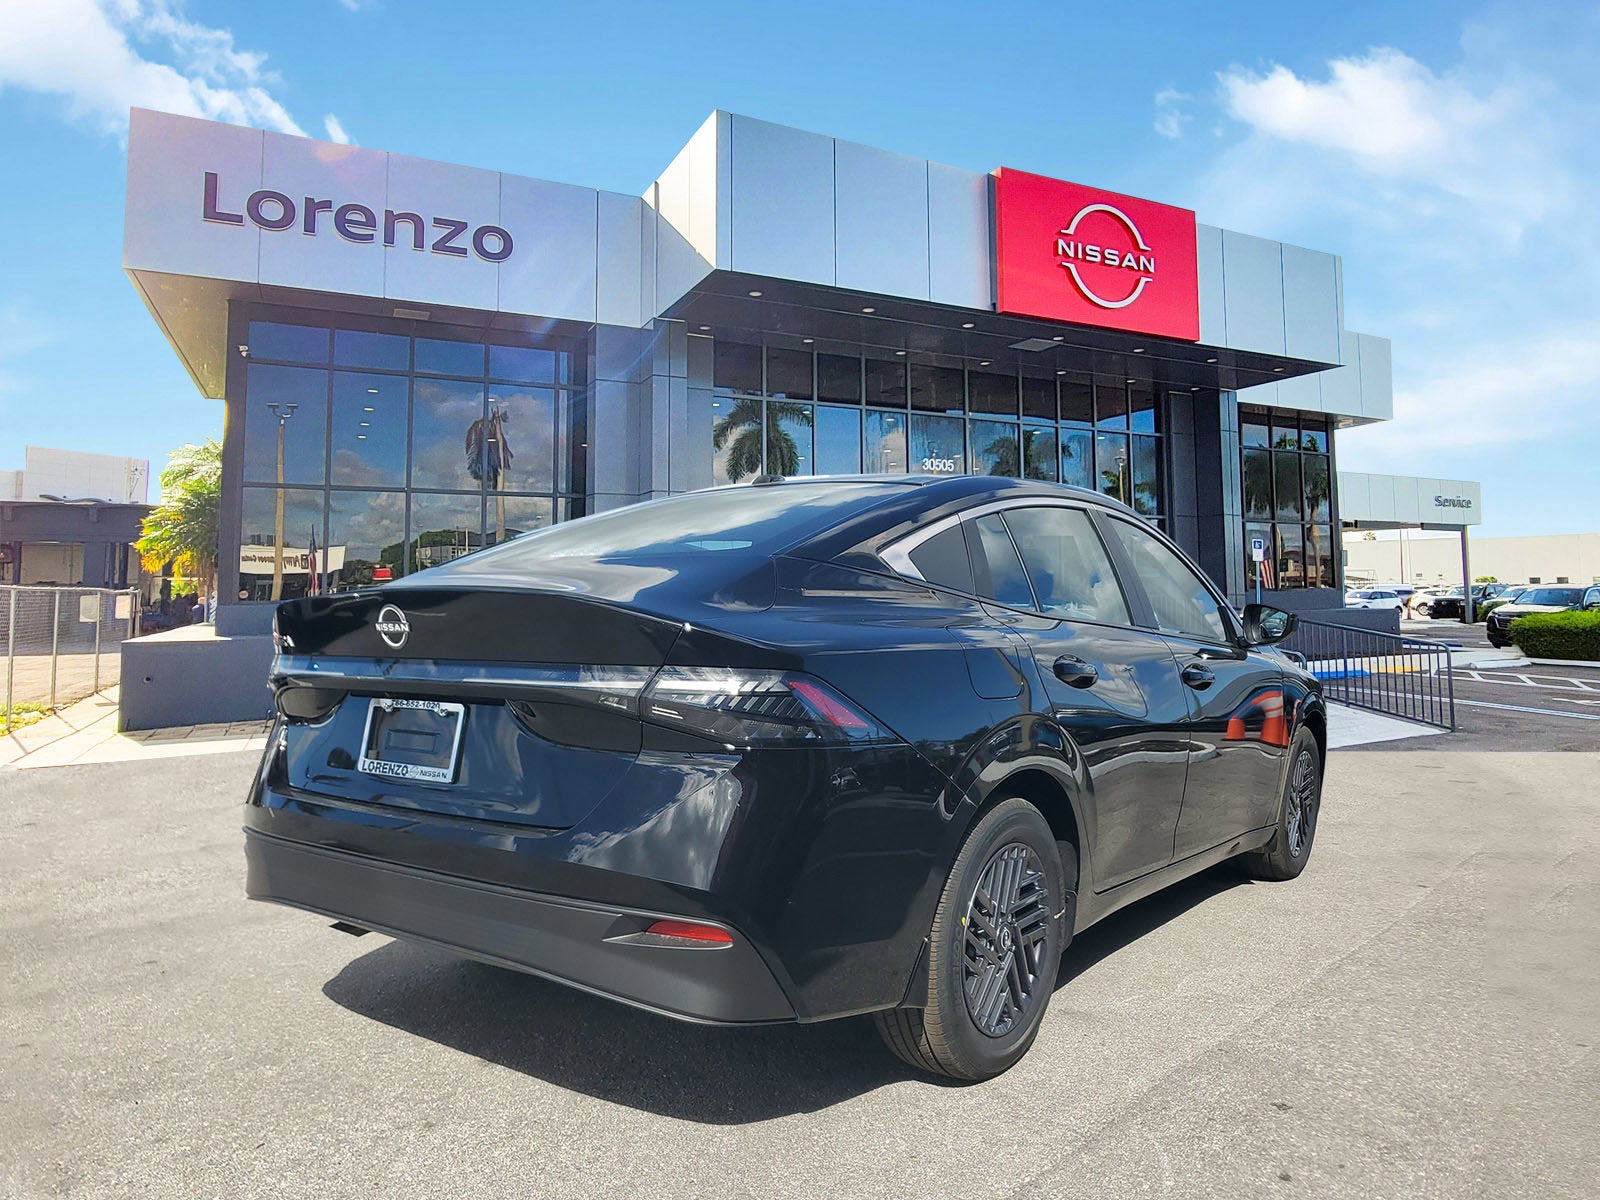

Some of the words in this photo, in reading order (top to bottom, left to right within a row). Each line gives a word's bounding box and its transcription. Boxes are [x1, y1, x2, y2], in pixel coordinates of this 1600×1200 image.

[203, 171, 514, 262] Lorenzo
[1057, 238, 1155, 273] NISSAN
[922, 457, 955, 472] 30505
[1434, 495, 1472, 509] Service
[375, 622, 410, 632] NISSAN
[361, 760, 409, 777] LORENZO
[420, 769, 448, 779] NISSAN
